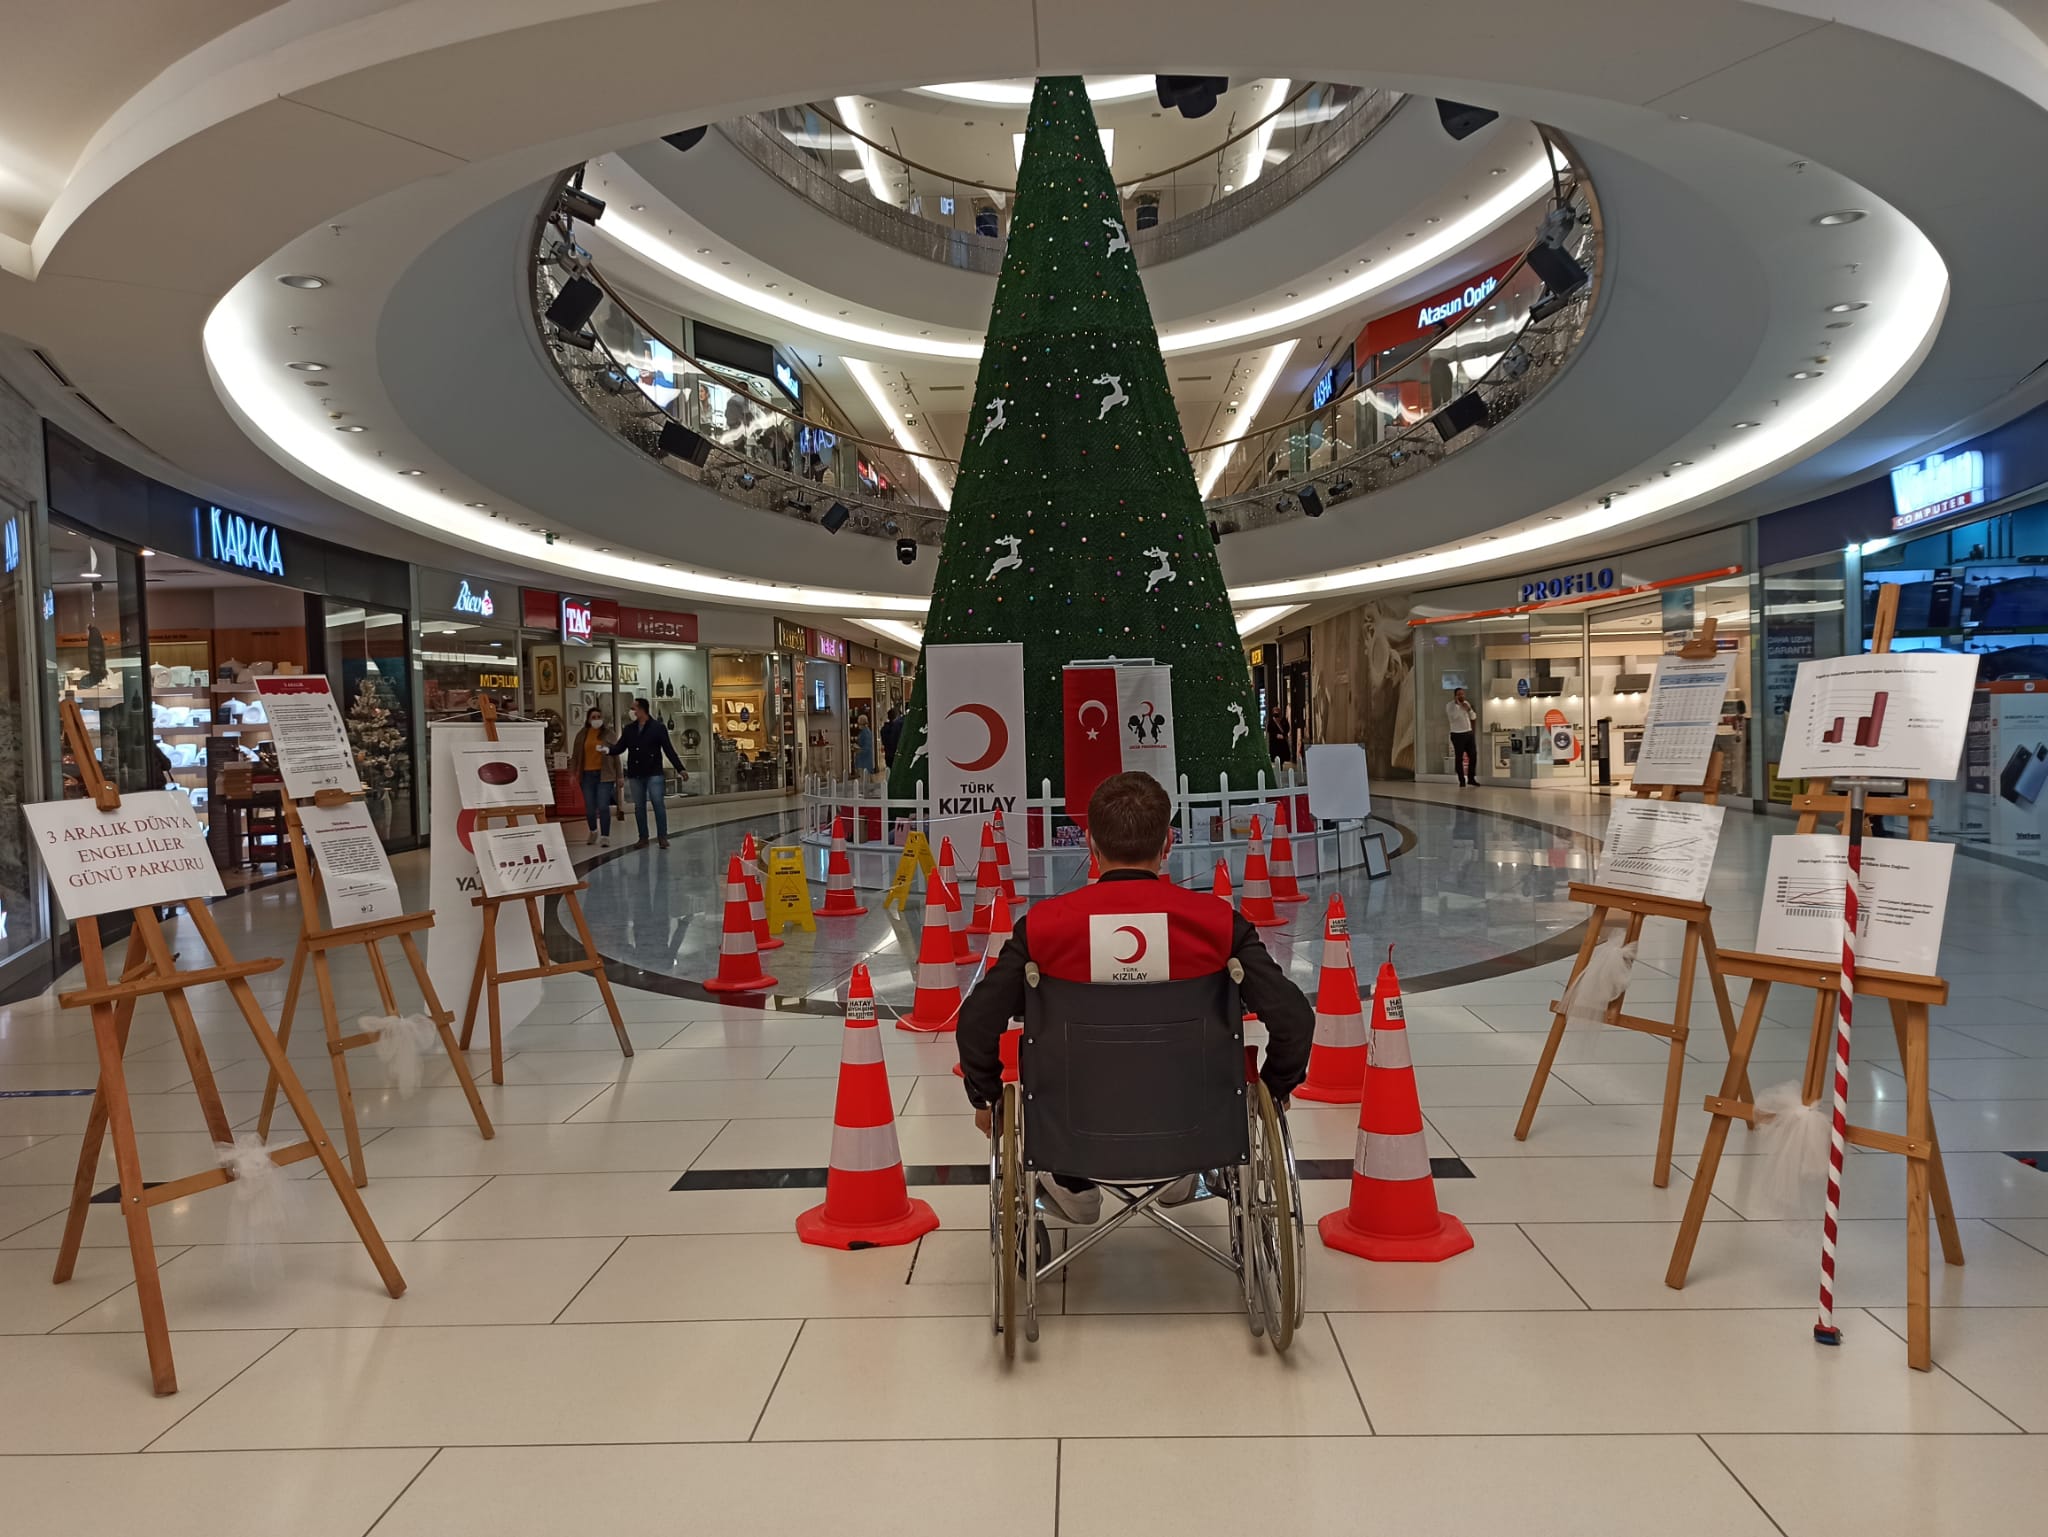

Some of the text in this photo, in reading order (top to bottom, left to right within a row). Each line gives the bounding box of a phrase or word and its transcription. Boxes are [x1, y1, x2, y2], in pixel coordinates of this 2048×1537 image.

[1418, 297, 1462, 328] Atasun
[1896, 496, 1966, 526] COMPUTER
[210, 506, 284, 577] KARACA
[566, 608, 590, 638] TAÇ
[579, 661, 613, 684] LUCK
[960, 782, 995, 794] TÜRK
[939, 797, 1017, 815] KIZILAY
[47, 816, 193, 844] 3 ARALIK DÜNYA
[77, 836, 185, 863] ENGELLİLER
[69, 857, 204, 888] GÜNÜ PARKURU
[1112, 972, 1147, 980] KIZILAY
